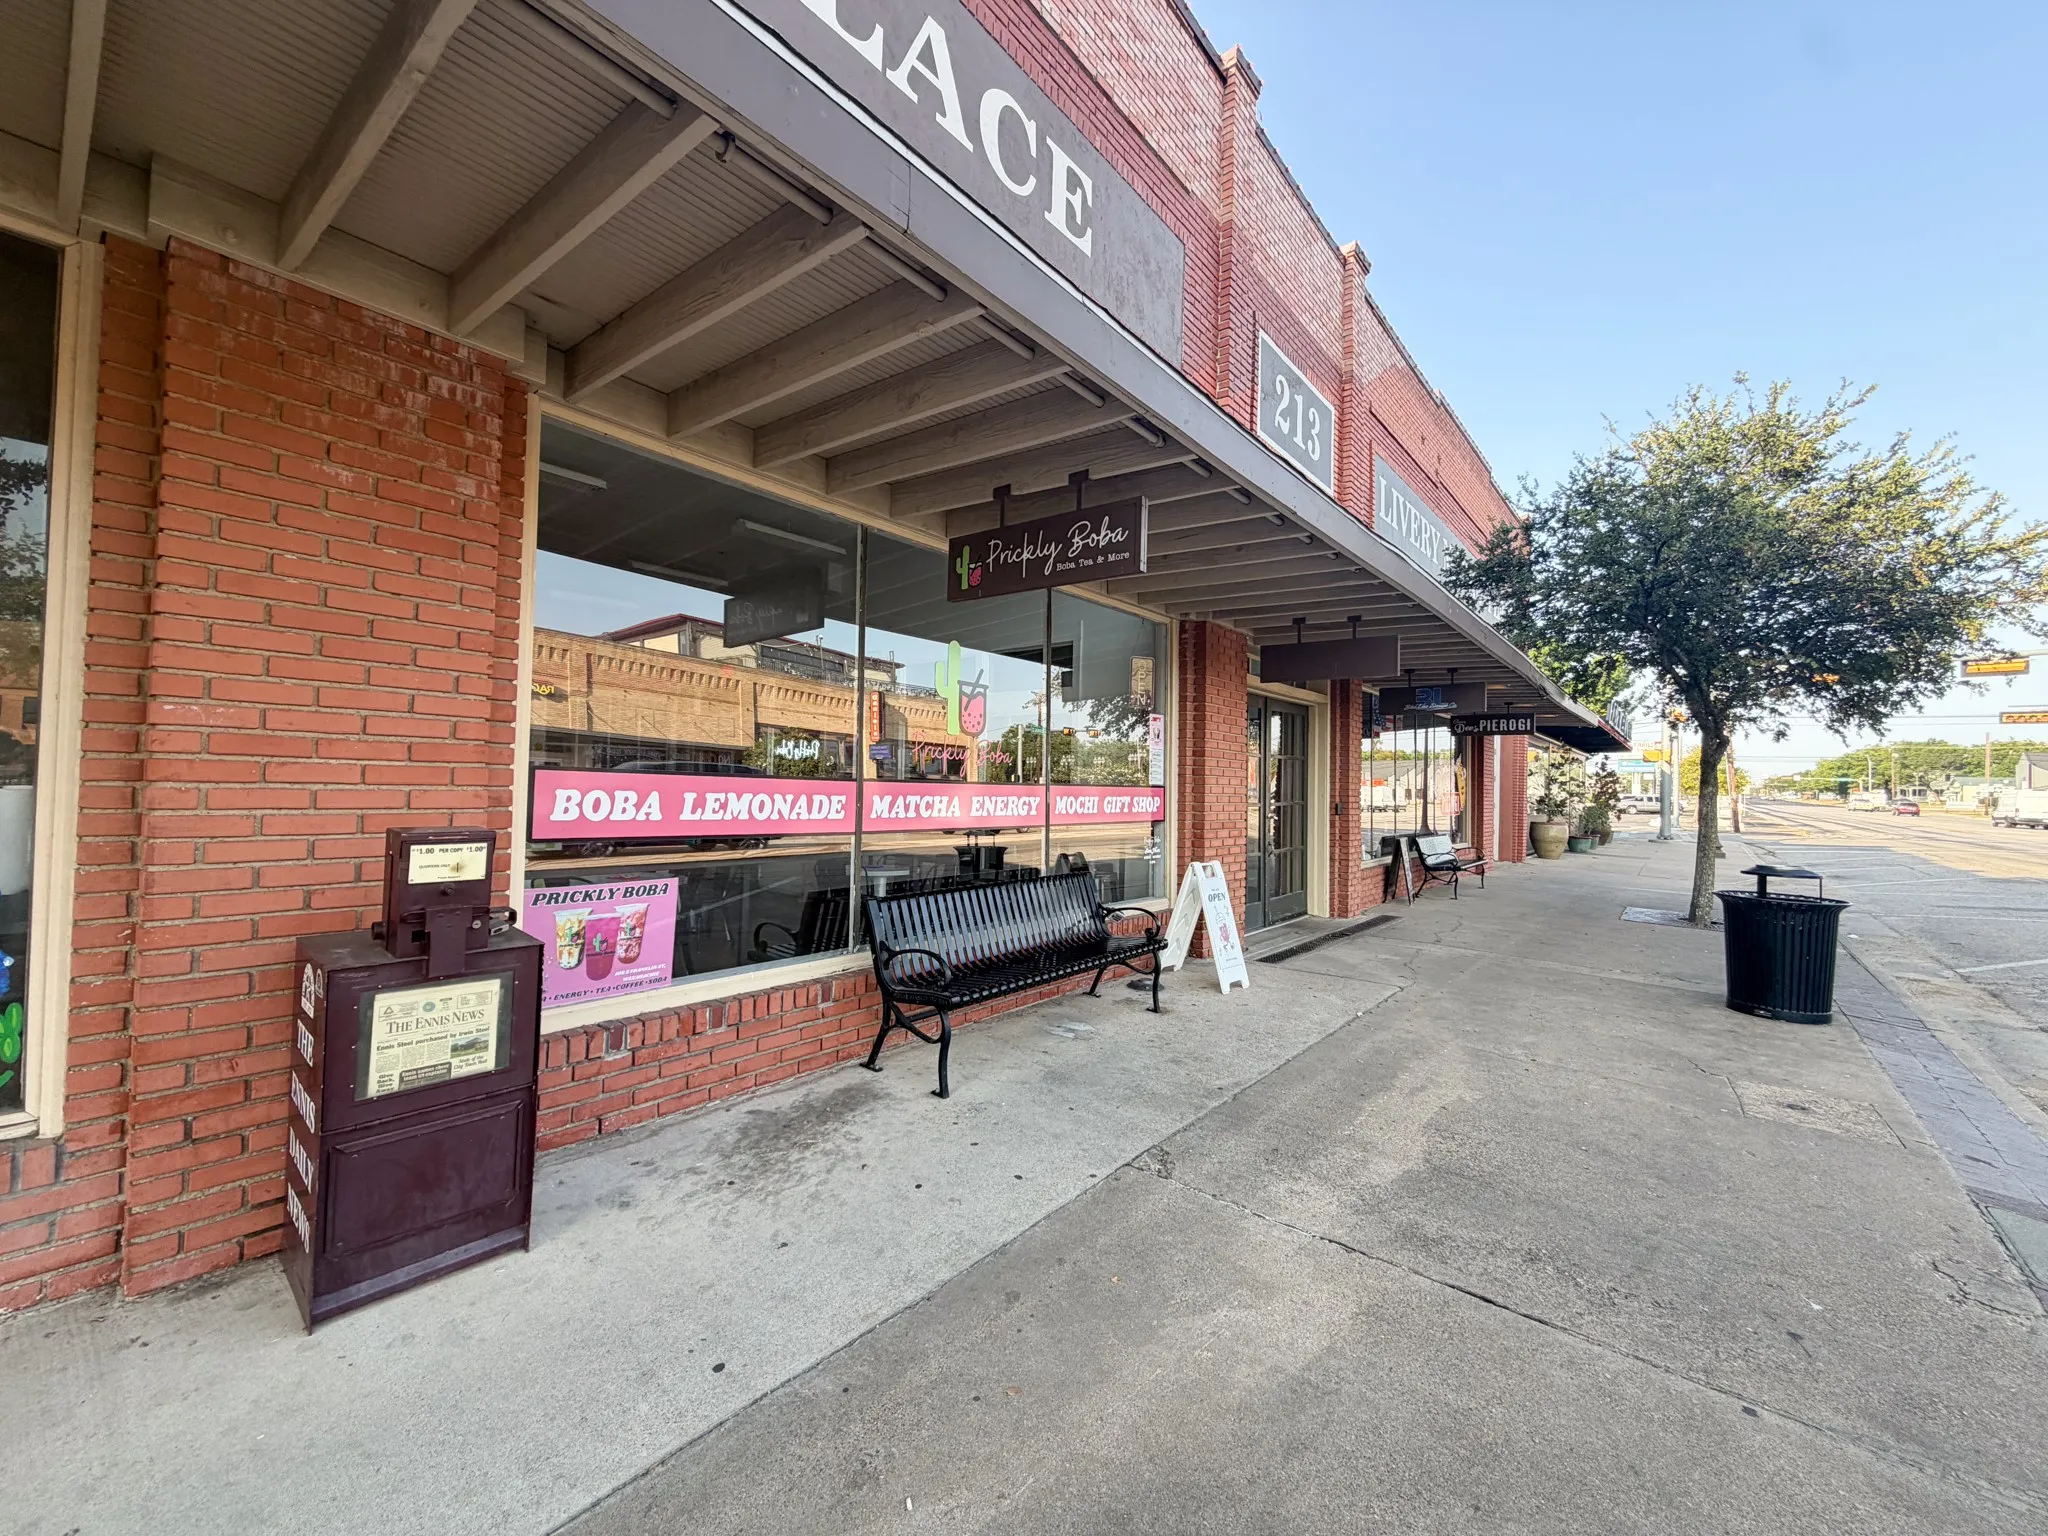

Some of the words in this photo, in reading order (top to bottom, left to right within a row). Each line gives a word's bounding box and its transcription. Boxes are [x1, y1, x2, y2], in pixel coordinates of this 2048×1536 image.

[1274, 374, 1321, 461] 213
[1378, 475, 1441, 565] LIVERY
[986, 530, 1063, 578] Prickly
[1067, 515, 1129, 557] Boba
[1056, 562, 1076, 572] Boba
[1078, 558, 1094, 568] Tea
[1096, 555, 1105, 564] &
[1107, 551, 1130, 562] More
[1454, 723, 1480, 734] Dee's
[1479, 718, 1531, 732] PIEROGI
[911, 731, 969, 777] Prickly
[976, 739, 1014, 767] Boba
[549, 788, 663, 822] BOBA
[678, 791, 847, 821] LEMONADE
[870, 794, 961, 819] MATCHA
[969, 795, 1041, 817] ENERGY
[1054, 795, 1100, 815] MOCHI
[1103, 795, 1131, 813] GIFT
[1131, 796, 1161, 813] SHOP
[530, 887, 621, 907] PRICKLY
[622, 882, 670, 899] BOBA
[1208, 892, 1226, 903] OPEN
[554, 989, 589, 1001] ENERGY
[596, 986, 611, 994] TEA
[615, 980, 644, 991] COFFEE
[647, 976, 668, 985] SODA
[376, 1043, 396, 1051] Ennis
[396, 1040, 414, 1048] Steel
[415, 1034, 448, 1045] purchased
[475, 1026, 490, 1034] Steel
[386, 1020, 413, 1034] THE
[415, 1016, 451, 1030] ENNIS
[452, 1009, 485, 1024] NEWS
[297, 1018, 314, 1068] THE
[291, 1069, 316, 1134] ENNIS
[289, 1125, 314, 1194] DAILY
[287, 1182, 310, 1254] NEWS
